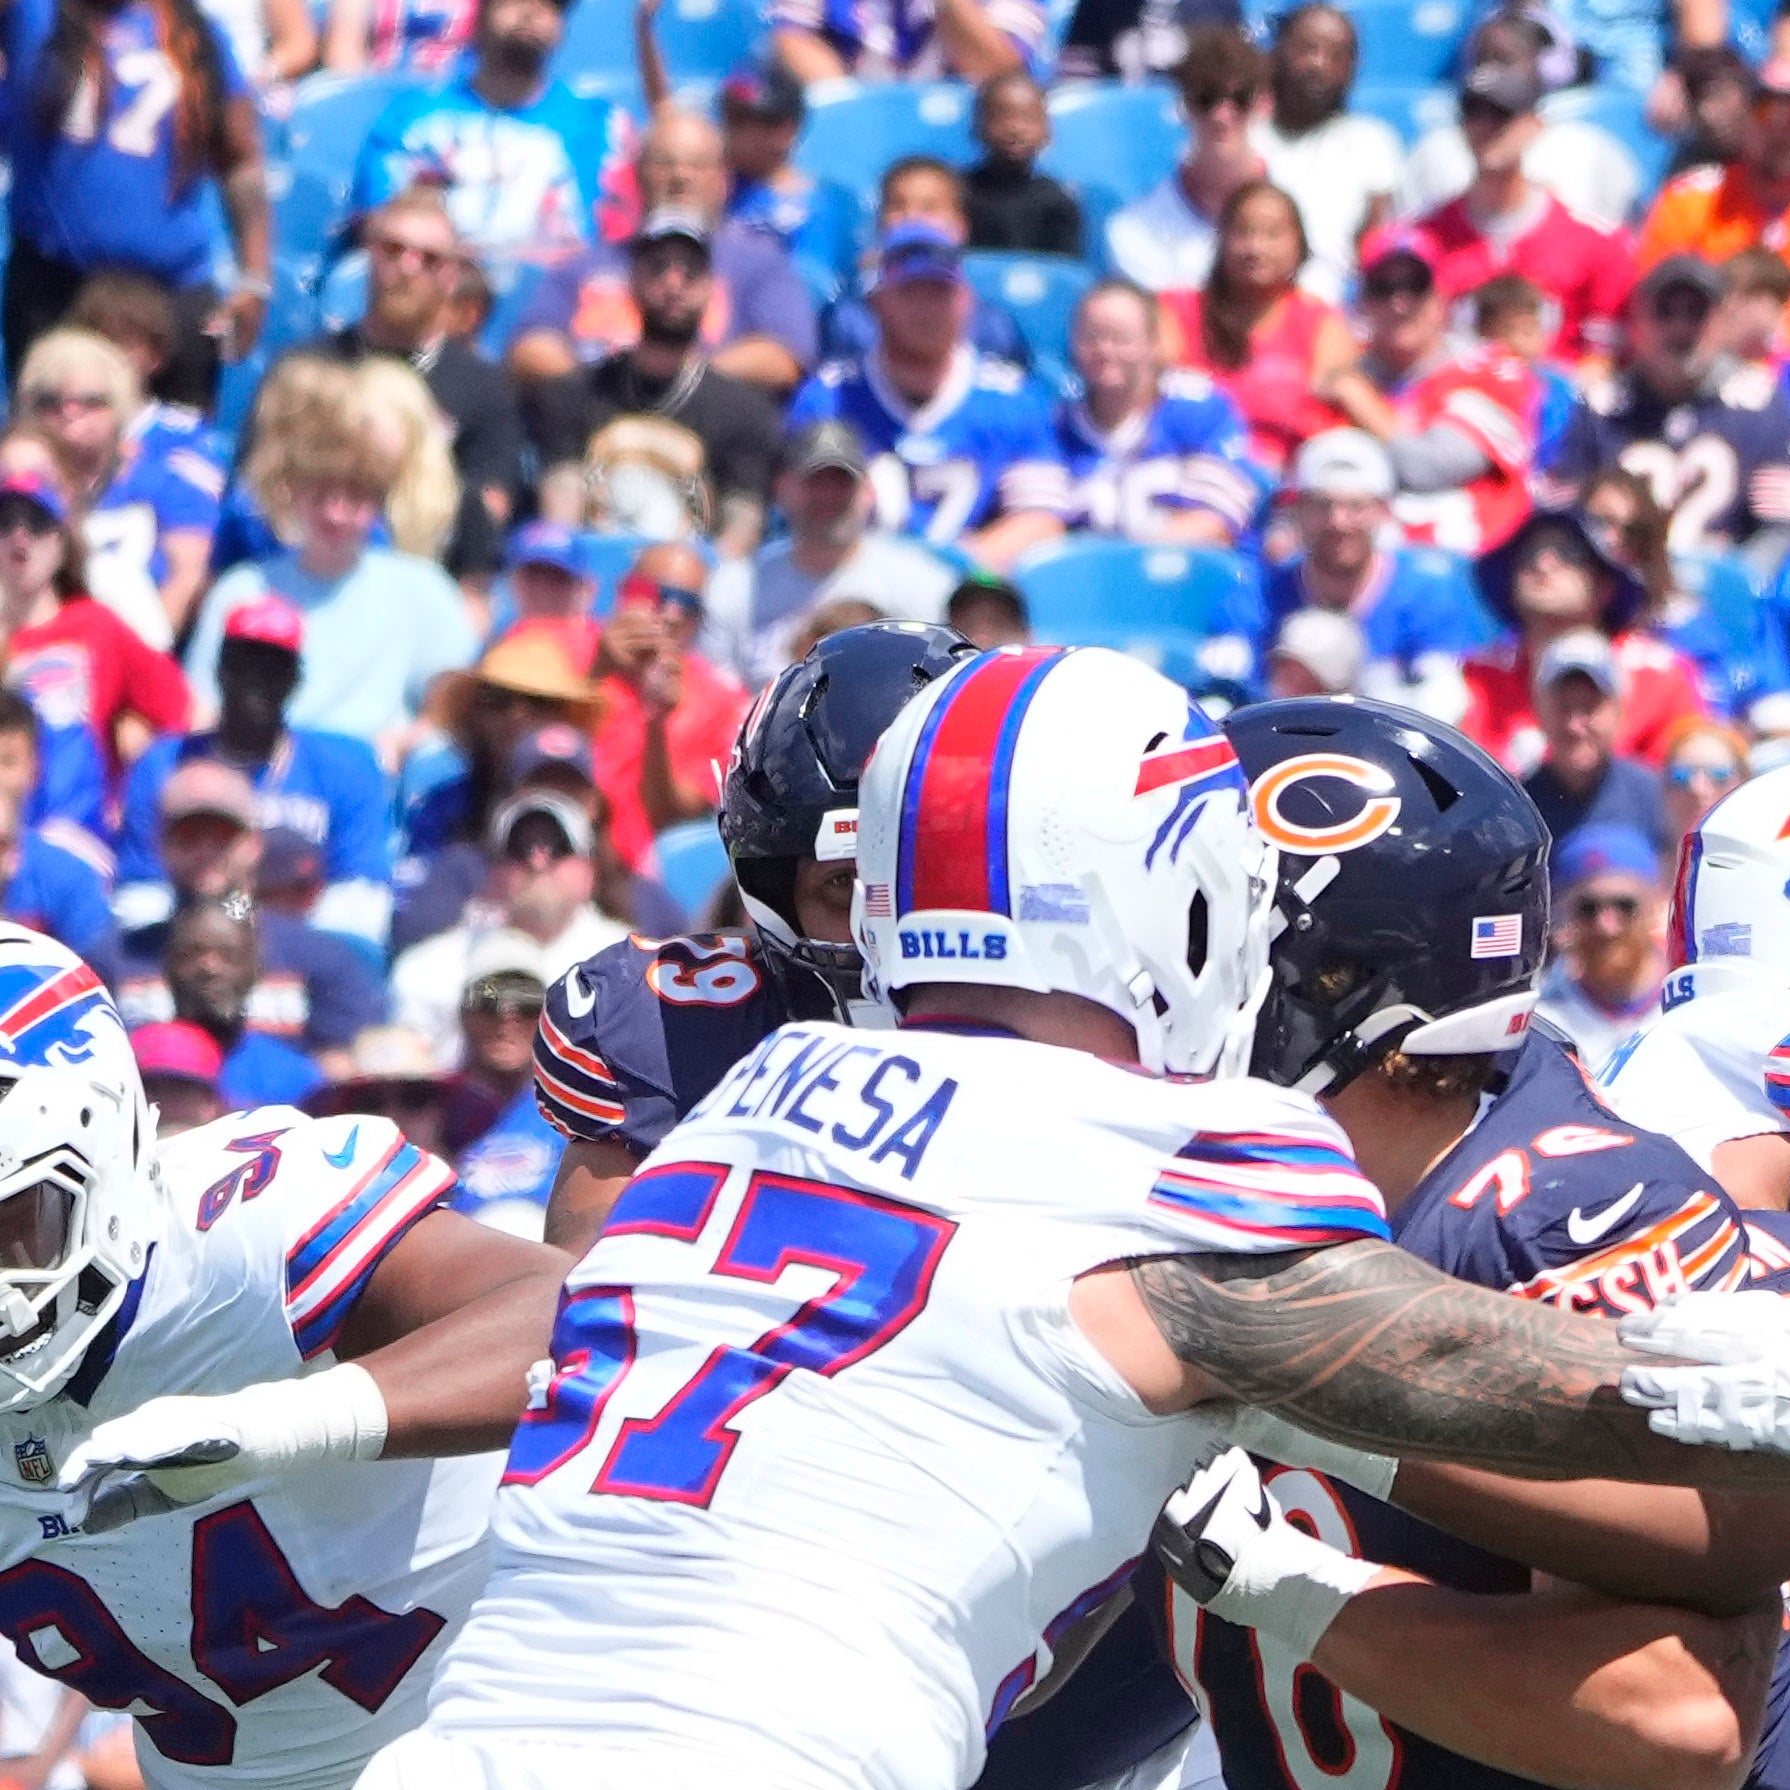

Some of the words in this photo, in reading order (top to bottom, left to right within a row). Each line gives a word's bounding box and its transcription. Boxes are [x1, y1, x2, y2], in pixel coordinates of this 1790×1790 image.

[900, 930, 1007, 960] BILLS
[1661, 974, 1695, 1014] LLS
[499, 1157, 962, 1512] 57
[19, 1456, 51, 1481] NFL
[0, 1500, 447, 1766] 94
